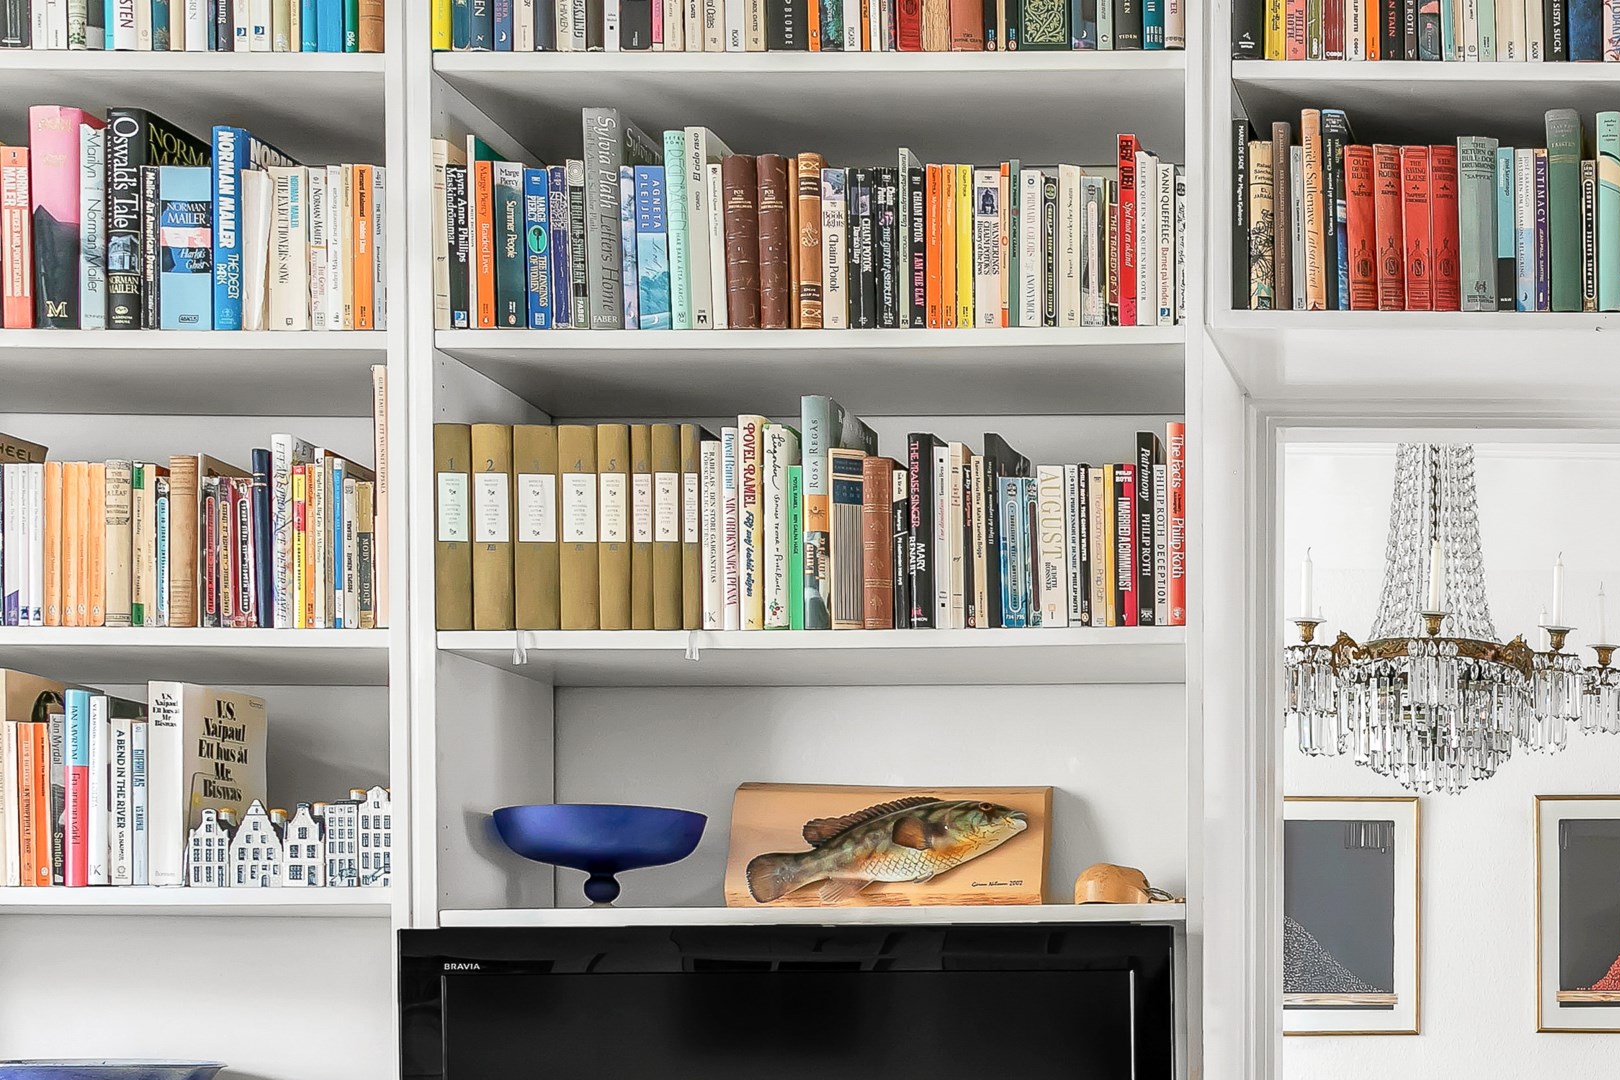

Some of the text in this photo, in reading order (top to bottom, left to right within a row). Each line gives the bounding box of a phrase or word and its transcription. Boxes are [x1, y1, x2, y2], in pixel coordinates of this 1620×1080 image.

[113, 117, 139, 229] Oswald's Tale
[500, 169, 520, 178] Marge
[500, 177, 518, 187] Piercy
[218, 132, 234, 248] NORMAN MAILER
[1536, 161, 1544, 224] INTIMACY
[166, 202, 206, 212] NORMAN
[459, 169, 468, 263] Jayne Anne Phillips
[527, 195, 536, 222] PIERCY
[537, 196, 546, 223] MARGE
[652, 180, 660, 229] AGNETA
[168, 213, 206, 225] MAILER
[507, 200, 517, 258] Summer People
[576, 300, 584, 323] FABER
[593, 315, 618, 324] FABER
[743, 423, 756, 508] POVEL RAMEL
[1040, 471, 1062, 560] AUGUST
[1140, 448, 1150, 576] Patrimony PHILIP ROTH
[1171, 435, 1184, 579] The Facts Philip Roth
[1156, 470, 1165, 604] PHILIP ROTH DECEPTION
[917, 543, 925, 571] MARY
[216, 700, 236, 720] V.S.
[52, 716, 62, 766] Jan Myrdal
[202, 718, 246, 744] Naipaul
[214, 763, 233, 783] Mr.
[203, 778, 243, 802] Biswas
[54, 832, 63, 869] Samtida
[444, 963, 481, 971] BRAVIA
